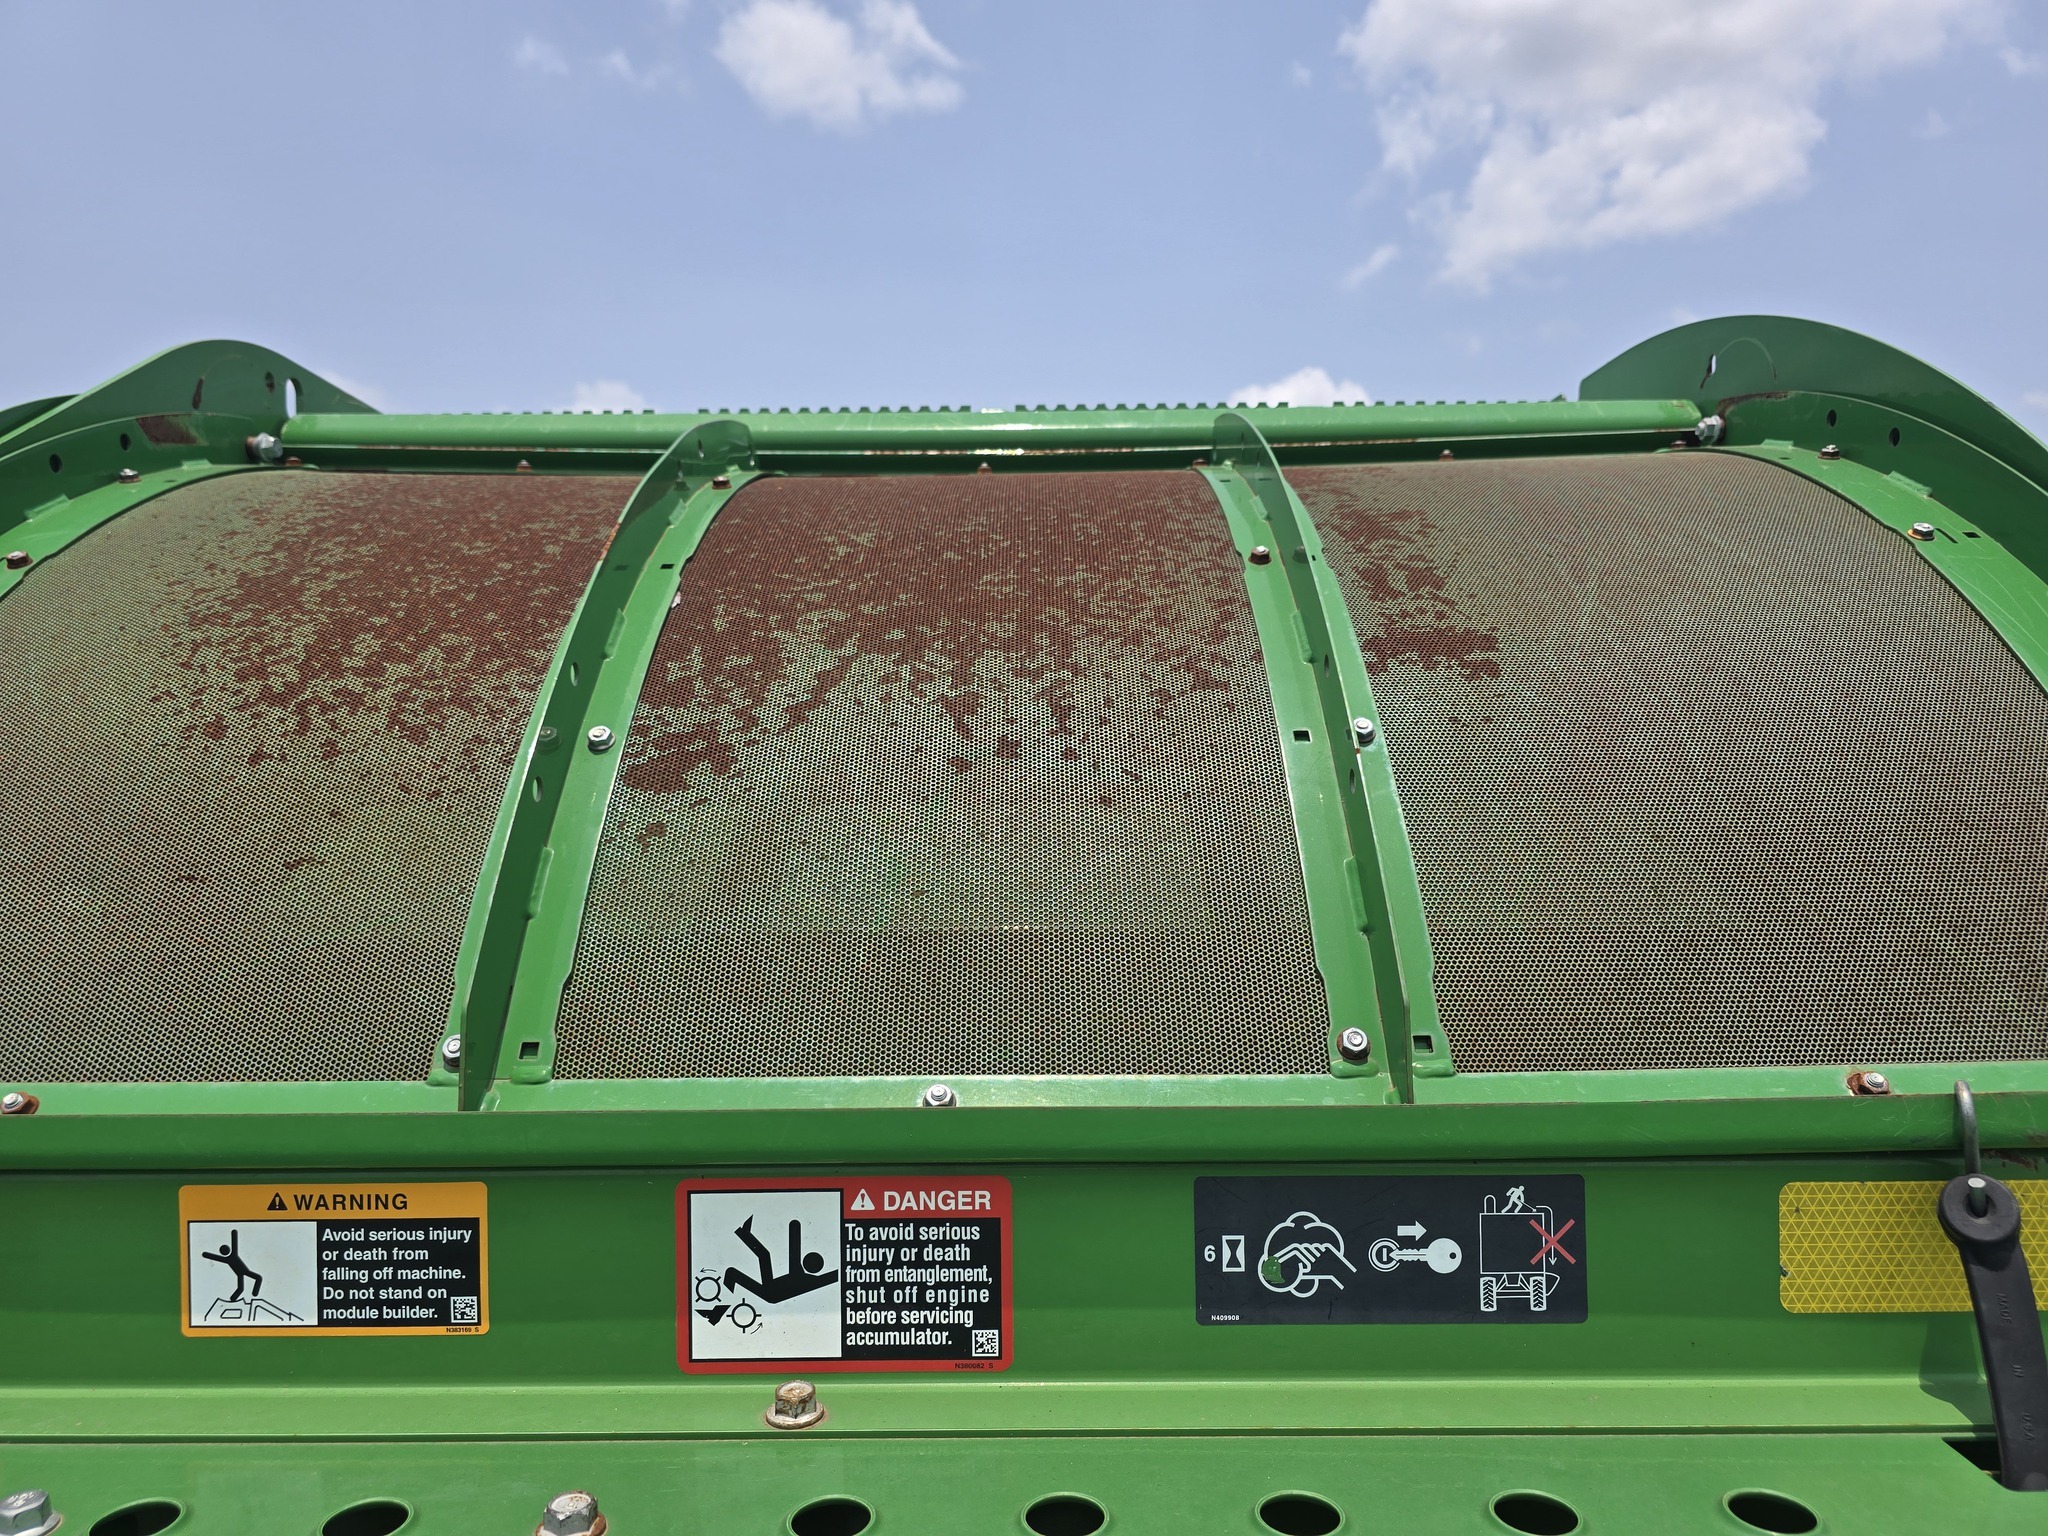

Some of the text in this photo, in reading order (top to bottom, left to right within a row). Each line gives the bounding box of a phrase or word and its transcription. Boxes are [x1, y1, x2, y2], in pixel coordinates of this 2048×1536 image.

[293, 1193, 408, 1211] WARNING
[883, 1190, 991, 1211] DANGER
[322, 1227, 472, 1244] Avoid serious injury
[845, 1222, 981, 1241] To avoid serious
[322, 1247, 429, 1261] or death from
[846, 1243, 971, 1266] injury or death
[1204, 1244, 1216, 1263] 6
[322, 1266, 466, 1283] falling off machine.
[845, 1264, 993, 1286] from entanglement,
[323, 1286, 447, 1300] Do not stand on
[845, 1285, 990, 1306] shut off engine
[323, 1305, 438, 1319] module builder.
[846, 1306, 974, 1327] before servicing
[846, 1328, 952, 1346] accumulator.
[1996, 1292, 2013, 1326] MADE
[2011, 1363, 2025, 1379] IN
